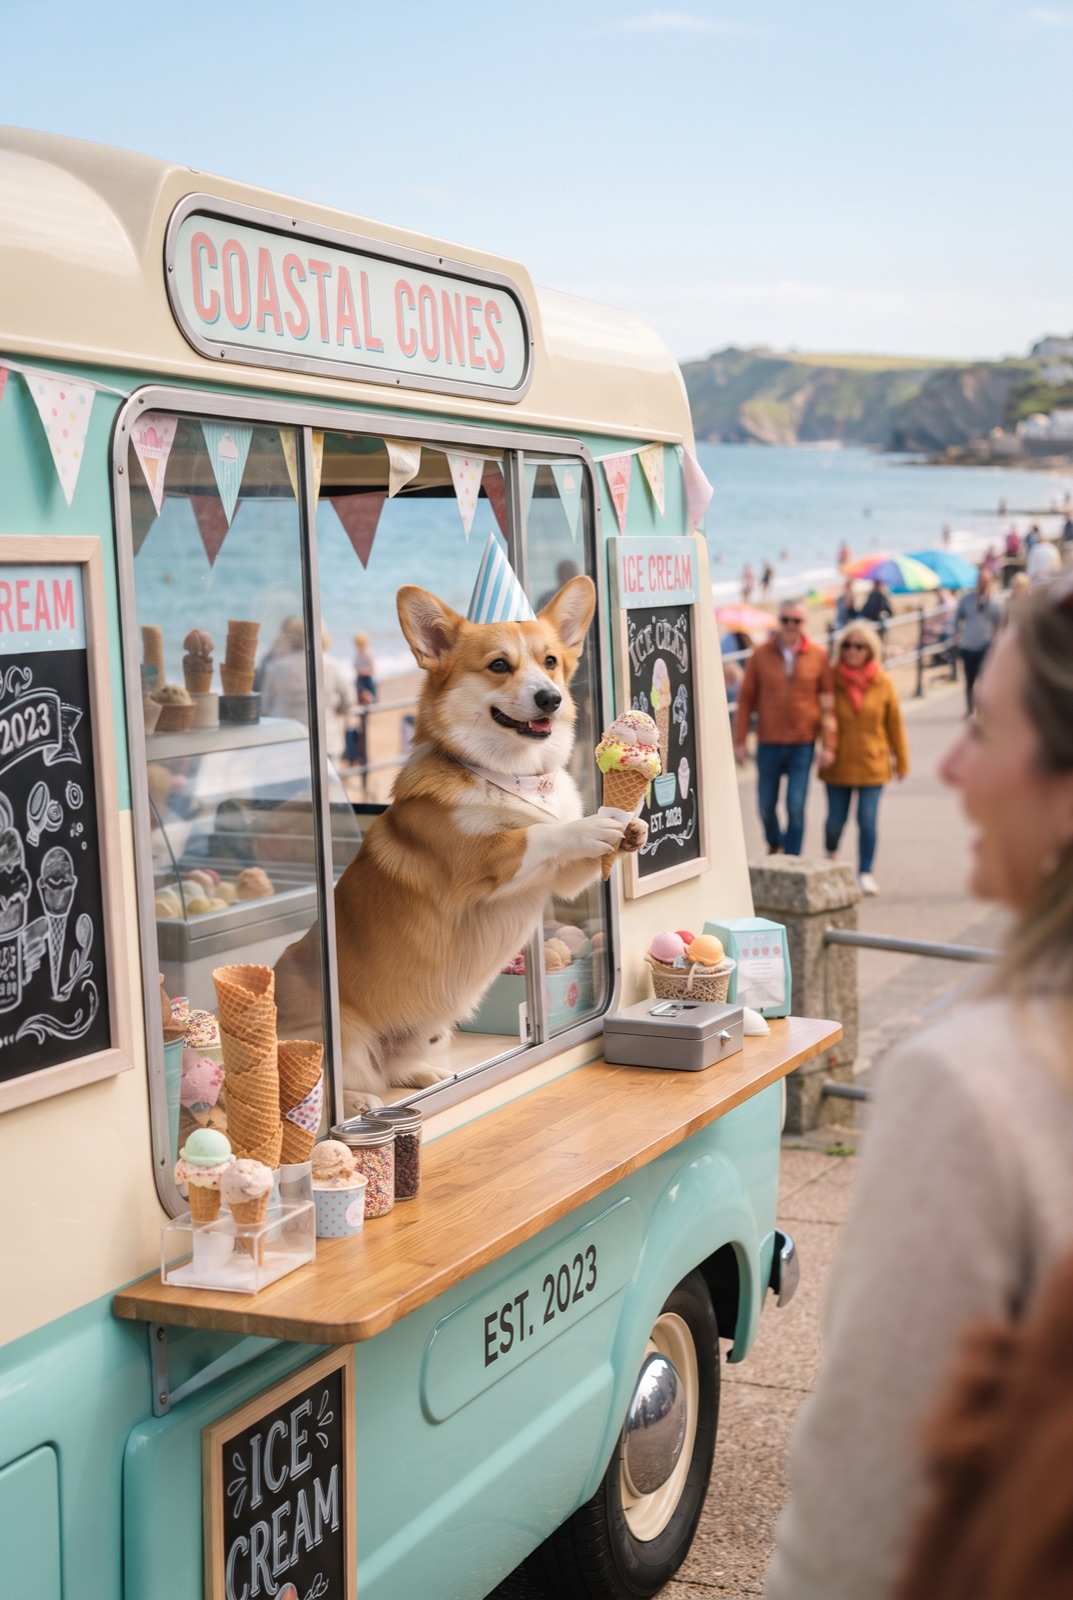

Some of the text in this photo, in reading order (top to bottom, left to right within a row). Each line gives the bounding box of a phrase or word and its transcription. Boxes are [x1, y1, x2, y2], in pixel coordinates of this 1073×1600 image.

[190, 231, 505, 374] COASTAL CONES
[622, 555, 693, 594] ICE CREAM
[0, 703, 51, 756] 2023
[650, 811, 665, 833] EST.
[484, 1244, 598, 1368] EST. 2023
[250, 1399, 313, 1511] ICE
[226, 1464, 340, 1600] CREAM
